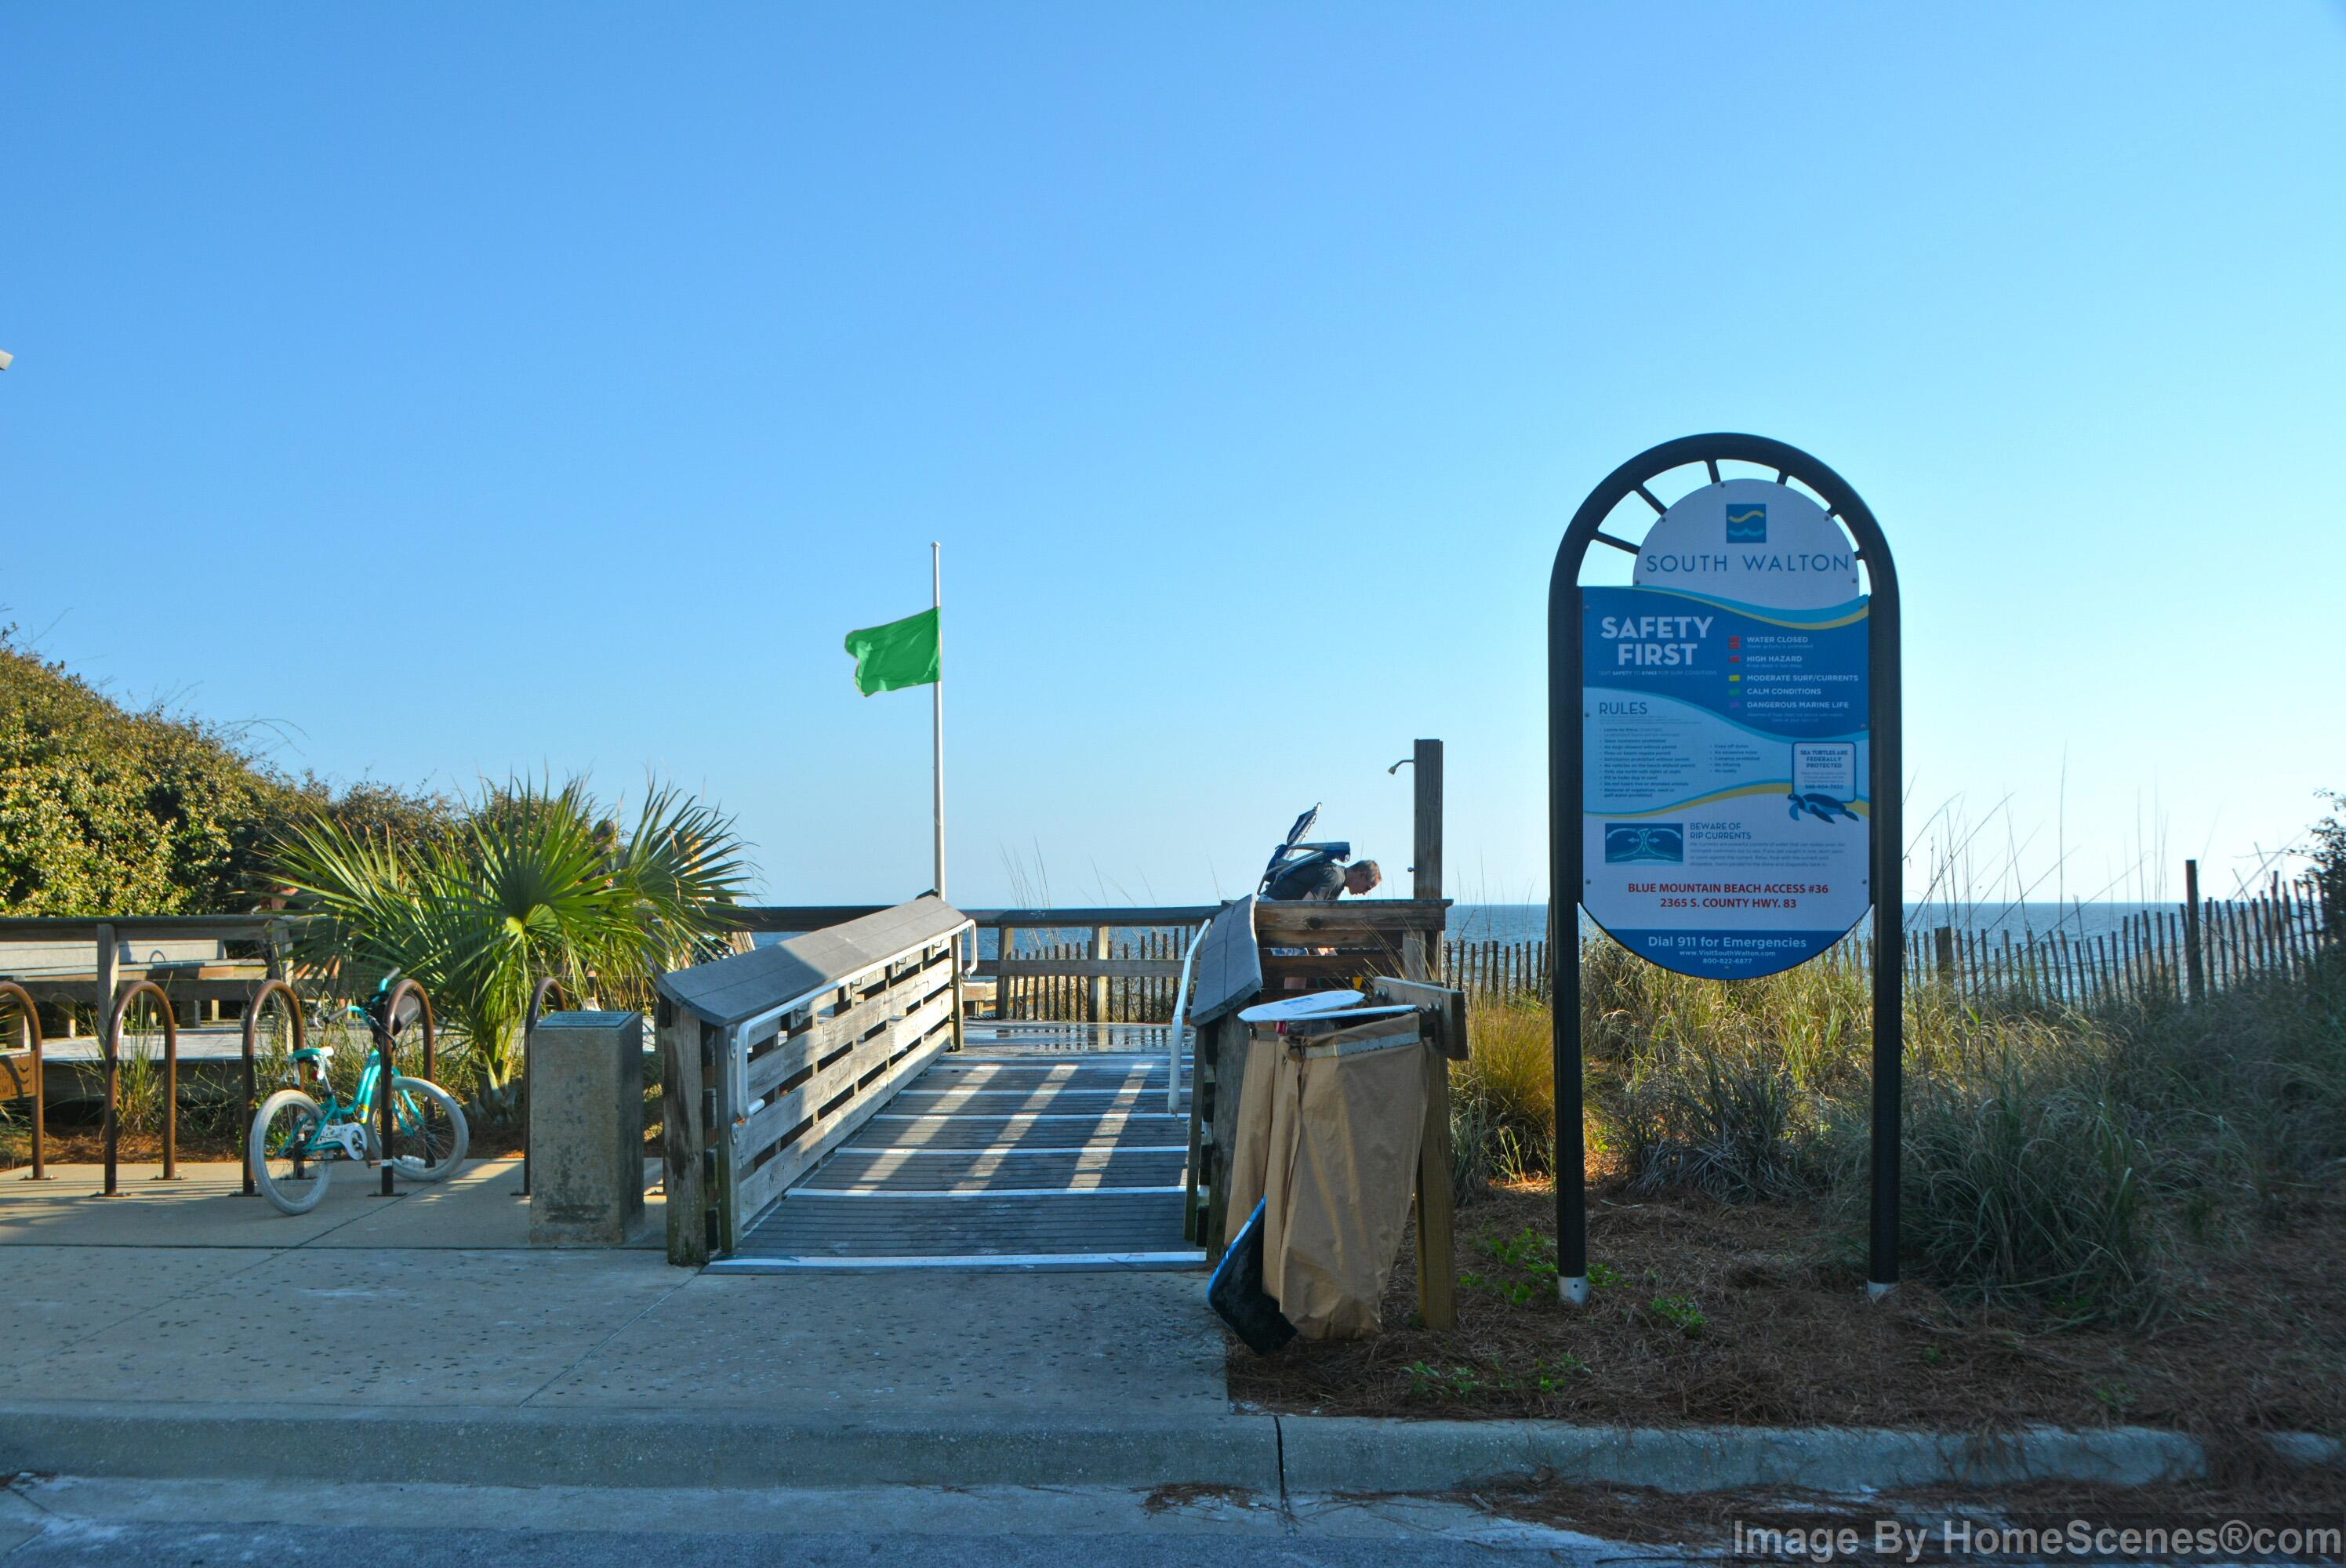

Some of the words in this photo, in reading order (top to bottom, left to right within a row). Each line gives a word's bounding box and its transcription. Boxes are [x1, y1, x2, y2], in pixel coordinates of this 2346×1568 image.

[1646, 554, 1727, 573] SOUTH
[1741, 554, 1849, 572] WALTON
[1600, 616, 1714, 640] SAFETY
[1618, 643, 1698, 666] FIRST
[1599, 701, 1648, 715] RULES
[1690, 822, 1727, 830] BEWARE
[1705, 831, 1752, 840] CURRENTS
[1628, 883, 1657, 893] BLUE
[1658, 883, 1721, 893] MOUNTAIN
[1723, 884, 1761, 894] BEACH
[1763, 884, 1807, 894] ACCESS
[1808, 884, 1829, 894] #36
[1660, 898, 1687, 908] 2365
[1690, 898, 1700, 908] S.
[1701, 898, 1749, 909] COUNTY
[1752, 898, 1781, 909] HWY.
[1782, 898, 1797, 909] 83
[1648, 935, 1673, 947] Dial
[1677, 936, 1696, 947] 911
[1700, 936, 1720, 947] for
[1723, 937, 1807, 949] Emergencies
